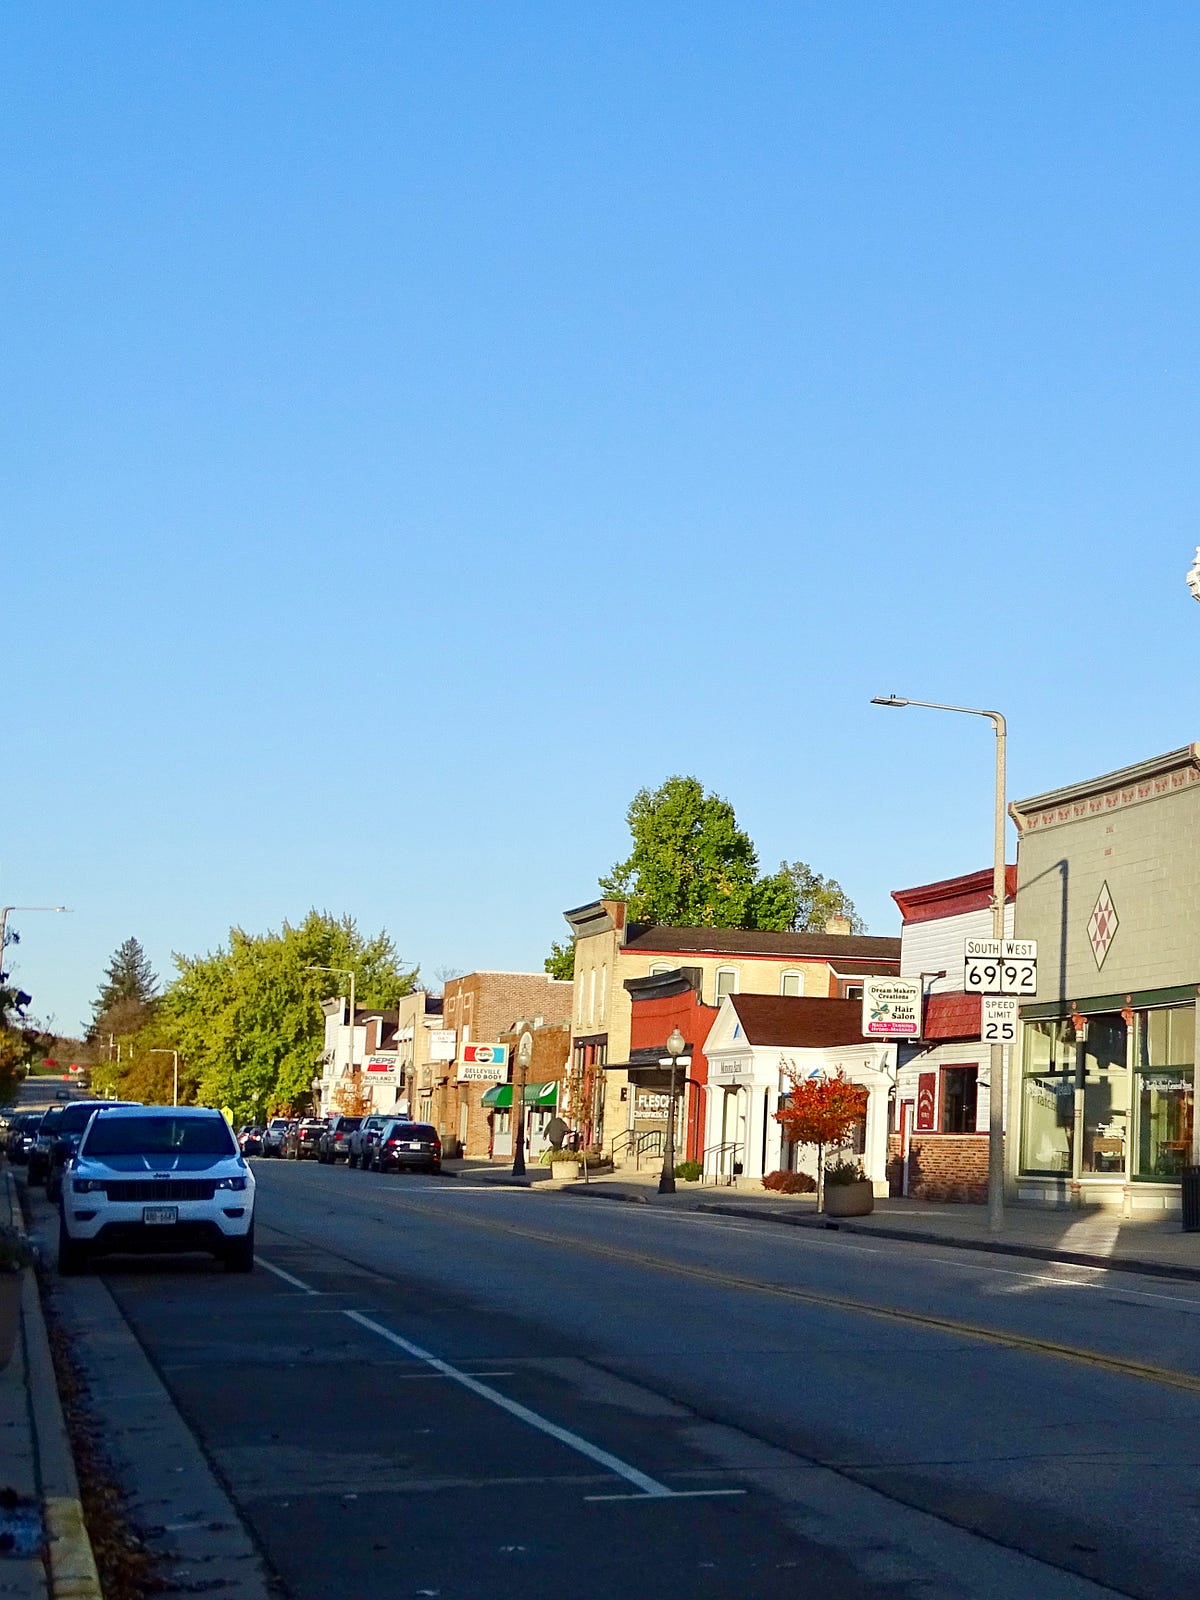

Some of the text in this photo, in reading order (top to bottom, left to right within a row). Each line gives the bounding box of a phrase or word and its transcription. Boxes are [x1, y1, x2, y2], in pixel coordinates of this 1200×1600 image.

[967, 941, 999, 954] SOUTH
[1006, 942, 1033, 955] WEST
[969, 965, 997, 985] 69
[1005, 966, 1033, 987] 92
[894, 1005, 914, 1013] Hair
[985, 1000, 1015, 1009] SPEED
[891, 1012, 916, 1020] Salon
[988, 1011, 1011, 1019] LIMIT
[986, 1022, 1014, 1039] 25
[464, 1067, 501, 1075] BELLEVILLE
